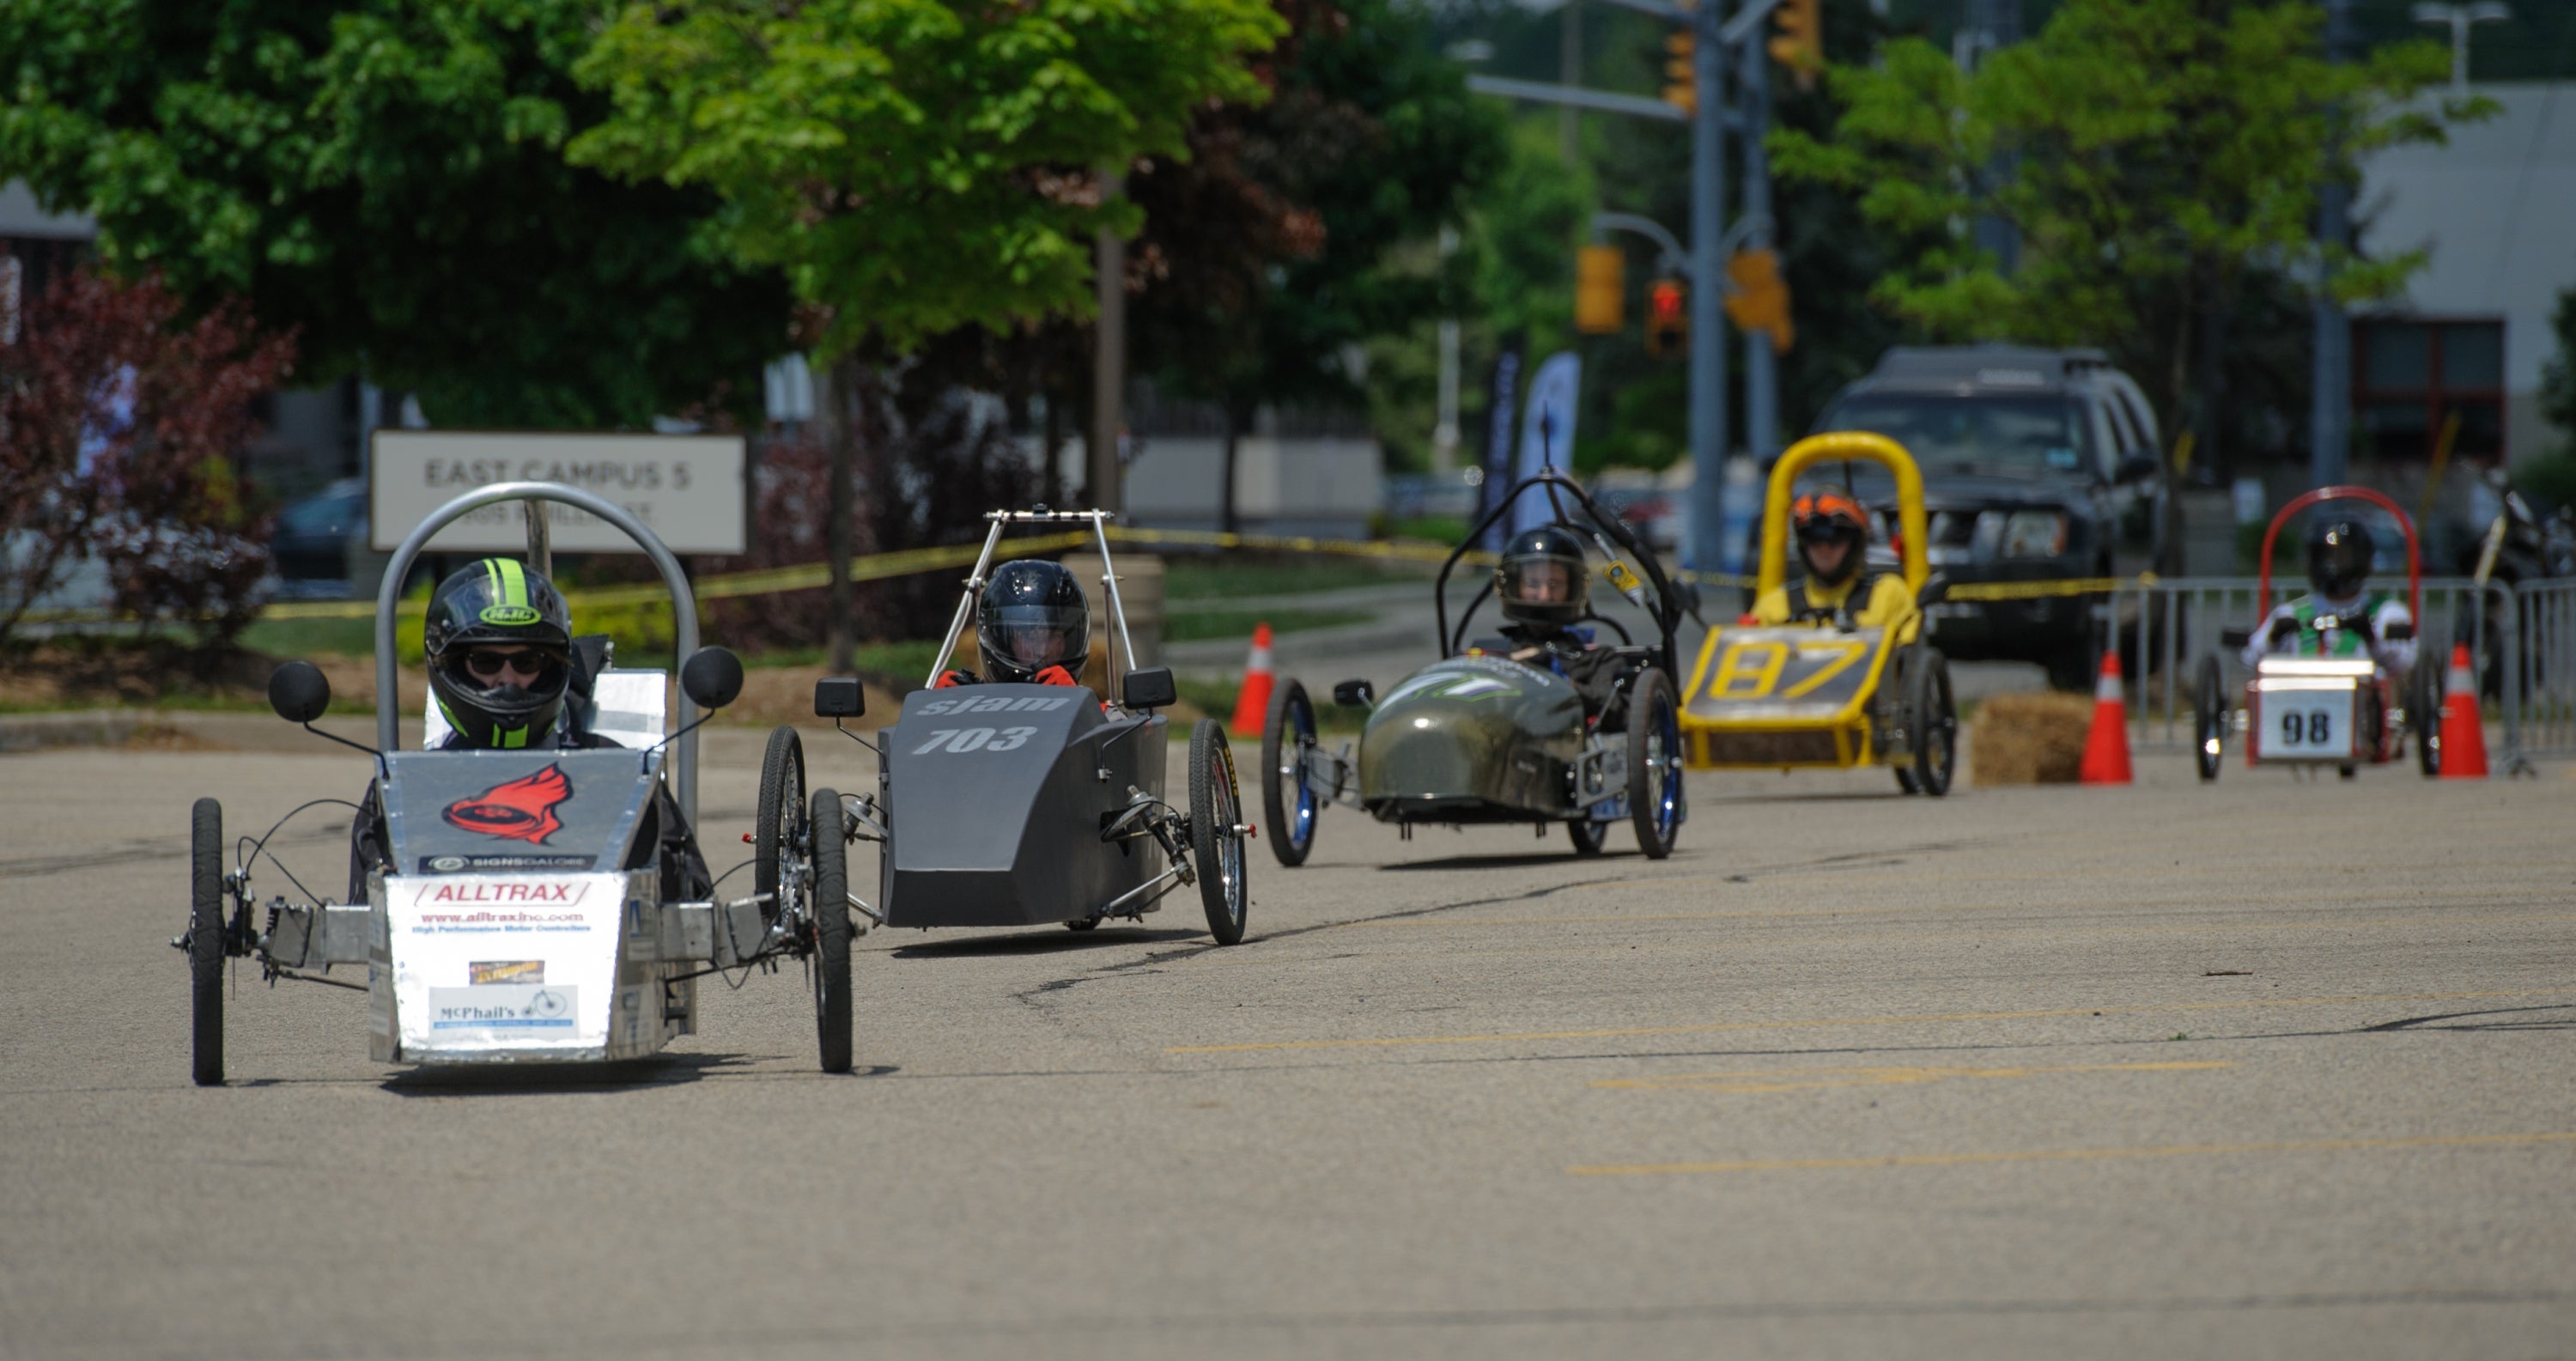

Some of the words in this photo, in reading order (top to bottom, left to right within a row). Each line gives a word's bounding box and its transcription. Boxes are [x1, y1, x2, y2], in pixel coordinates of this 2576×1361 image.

[424, 458, 510, 488] EAST
[519, 459, 664, 490] CAMPUS
[671, 461, 694, 490] 5
[1708, 641, 1868, 699] 87
[915, 695, 1071, 715] sjam
[911, 726, 1038, 755] 703
[2281, 712, 2330, 744] 98
[434, 884, 570, 901] ALLTRAX
[421, 912, 584, 923] www.alltraxinc.com
